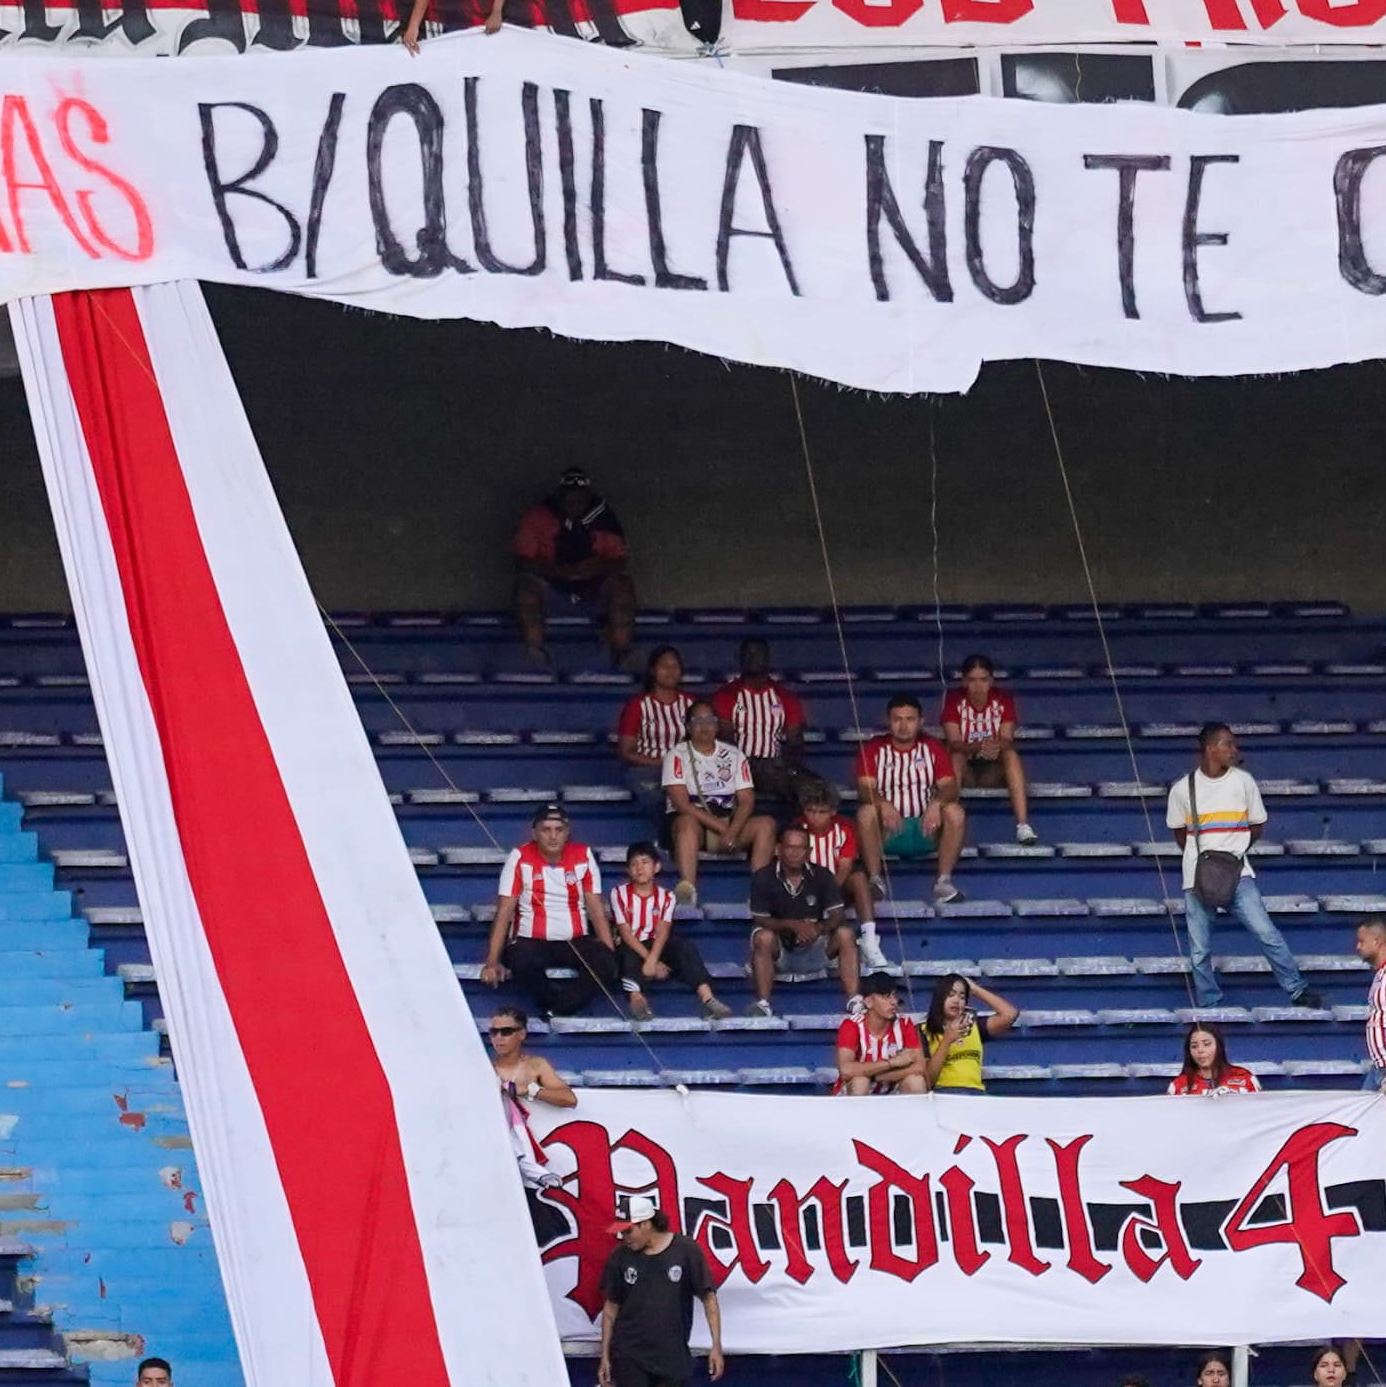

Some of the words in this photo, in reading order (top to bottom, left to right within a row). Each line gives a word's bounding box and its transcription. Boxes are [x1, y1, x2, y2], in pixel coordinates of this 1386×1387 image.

[198, 74, 803, 298] B/QUILLA
[865, 133, 1037, 307] NO
[1083, 152, 1244, 323] TE
[1224, 1121, 1360, 1305] 4
